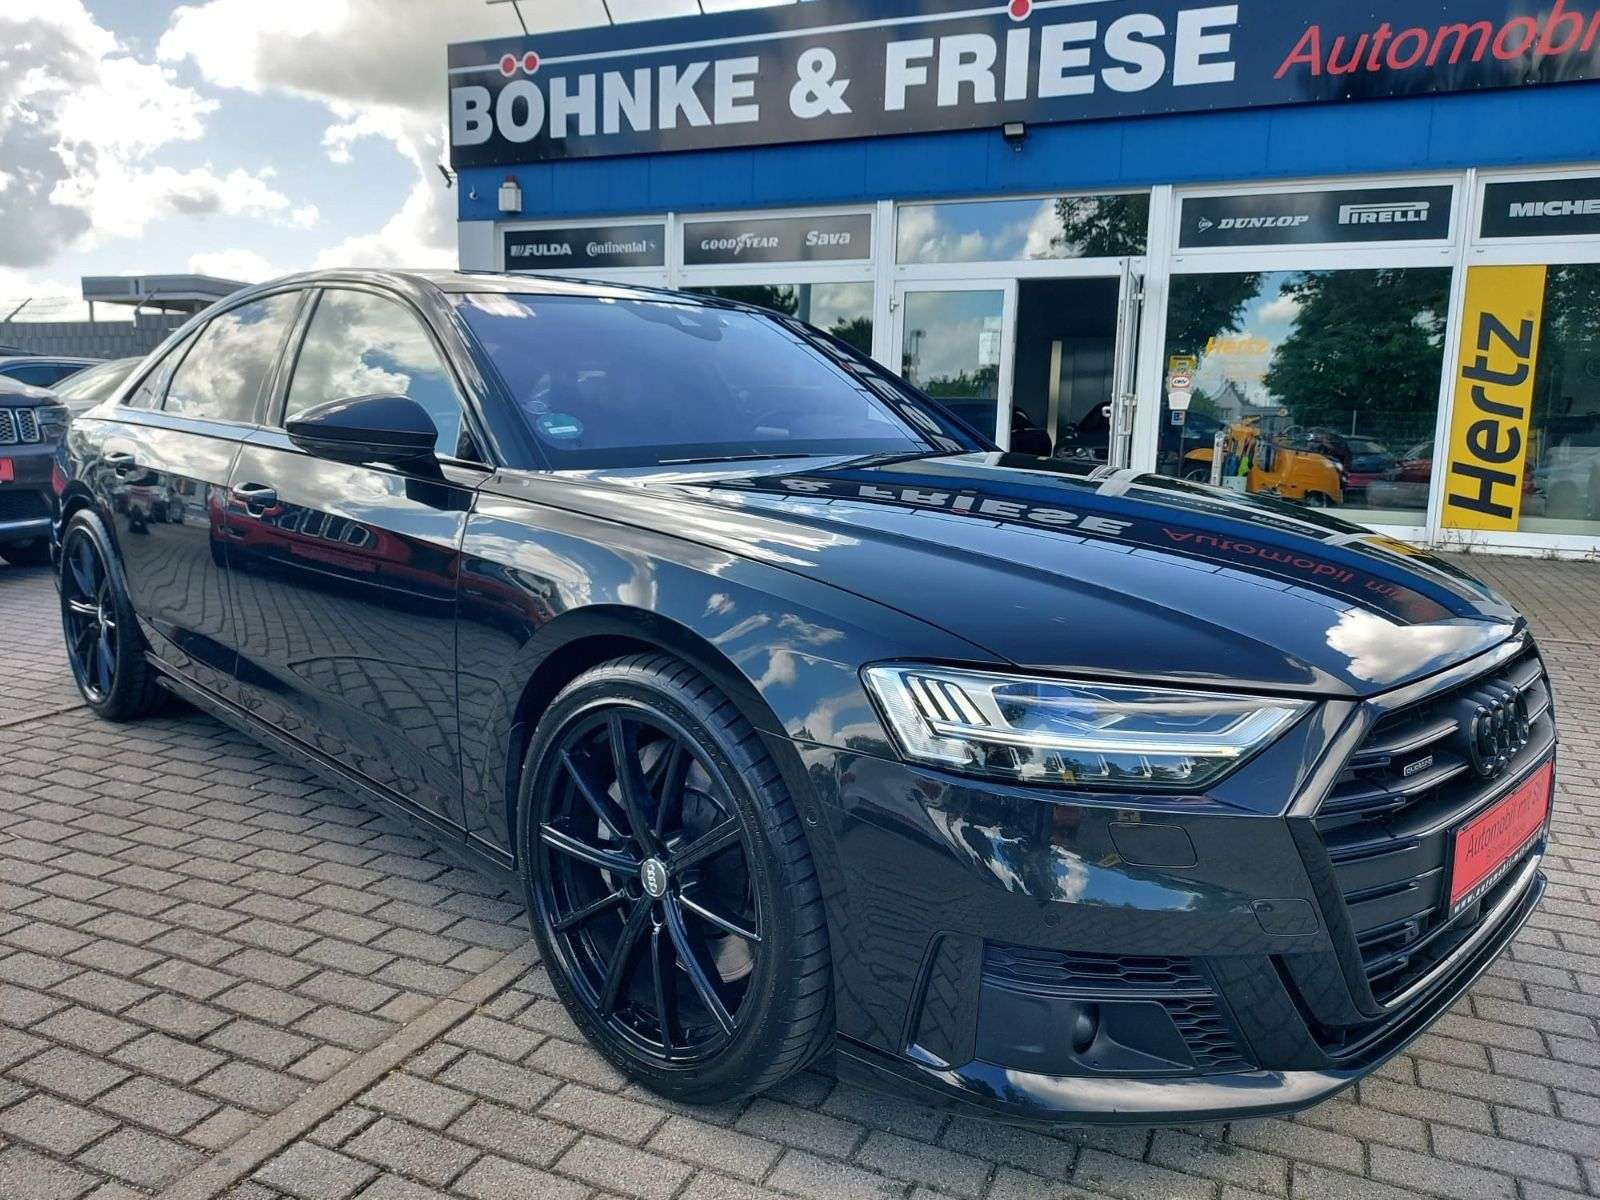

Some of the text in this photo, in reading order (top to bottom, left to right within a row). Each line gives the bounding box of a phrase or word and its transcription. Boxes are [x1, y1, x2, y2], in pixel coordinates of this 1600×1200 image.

[450, 50, 761, 147] BÖHNKE
[788, 46, 853, 119] &
[1338, 200, 1431, 225] PIRELLI
[1217, 214, 1310, 230] DUNLOP
[805, 229, 852, 247] Sava
[522, 243, 573, 257] FULDA
[585, 239, 648, 257] Continental
[1448, 311, 1535, 520] Hertz
